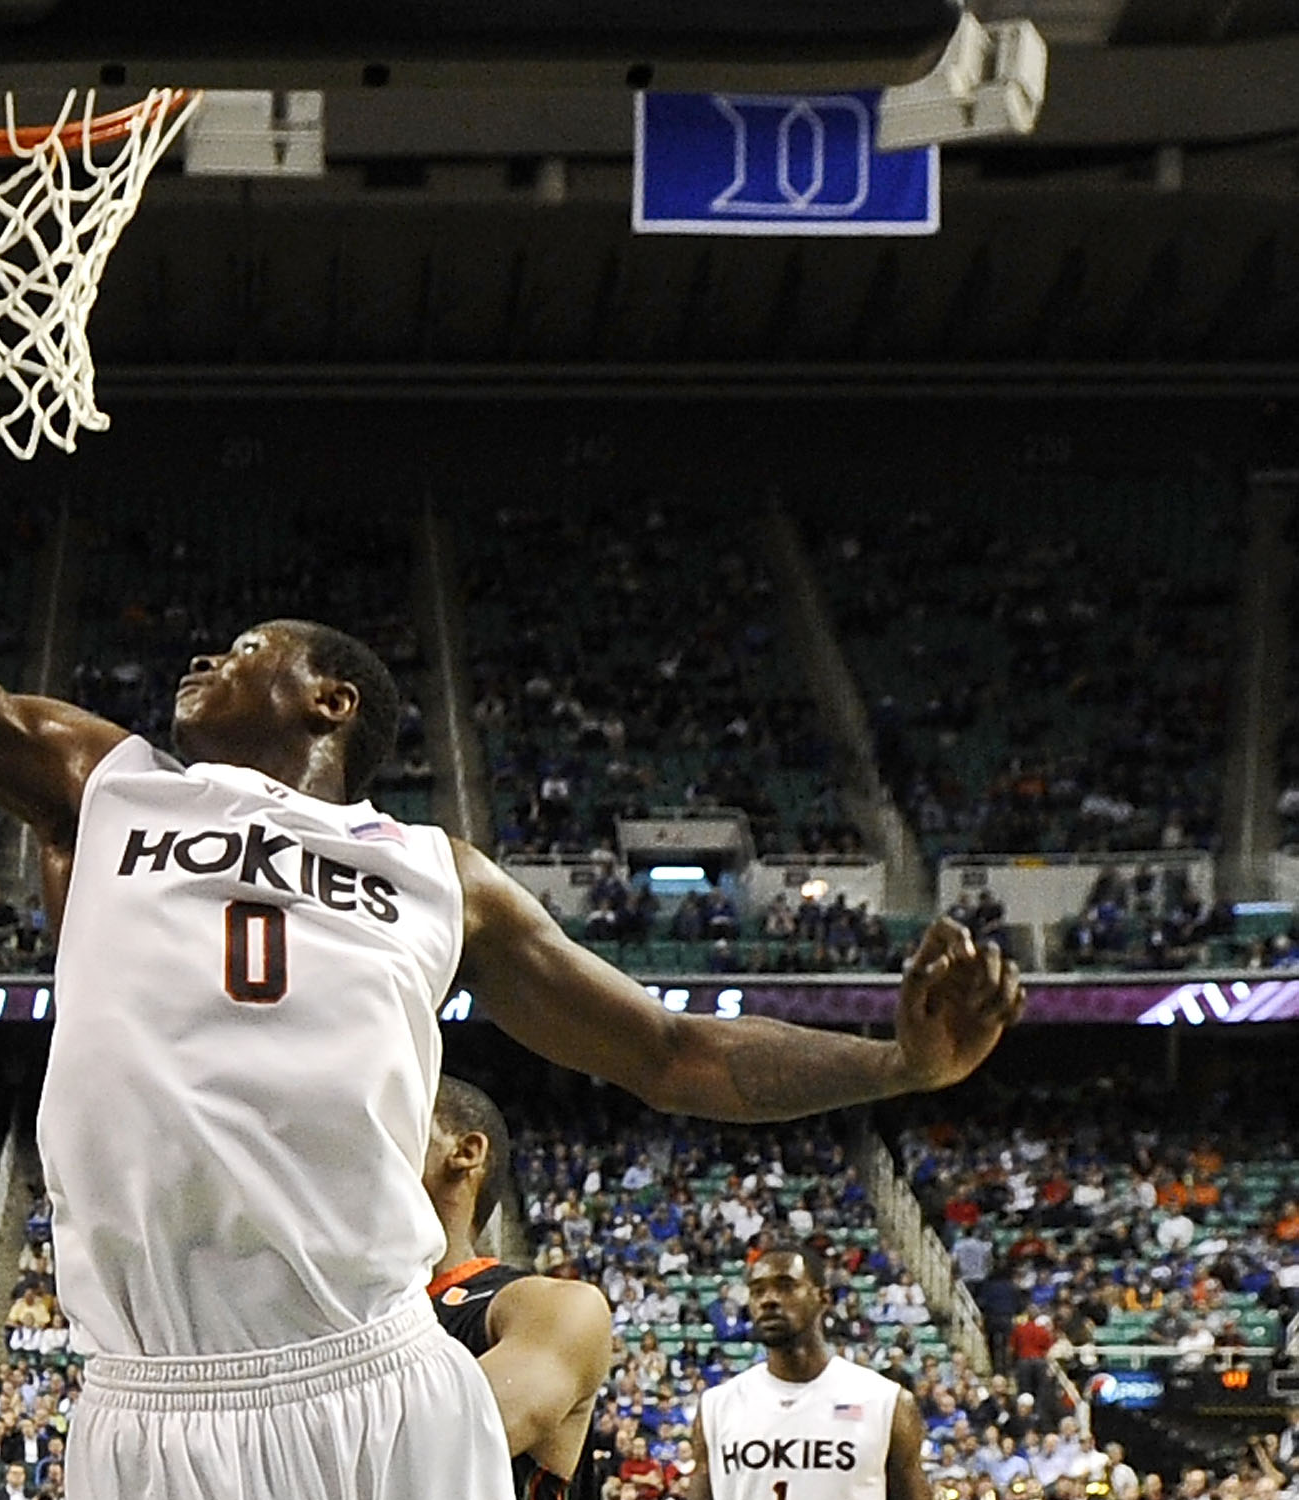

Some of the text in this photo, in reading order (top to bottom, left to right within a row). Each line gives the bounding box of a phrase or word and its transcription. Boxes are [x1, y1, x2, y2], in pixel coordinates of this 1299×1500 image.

[118, 823, 399, 923] HOKIES
[225, 899, 287, 1003] 0
[721, 1439, 857, 1475] HOKIES
